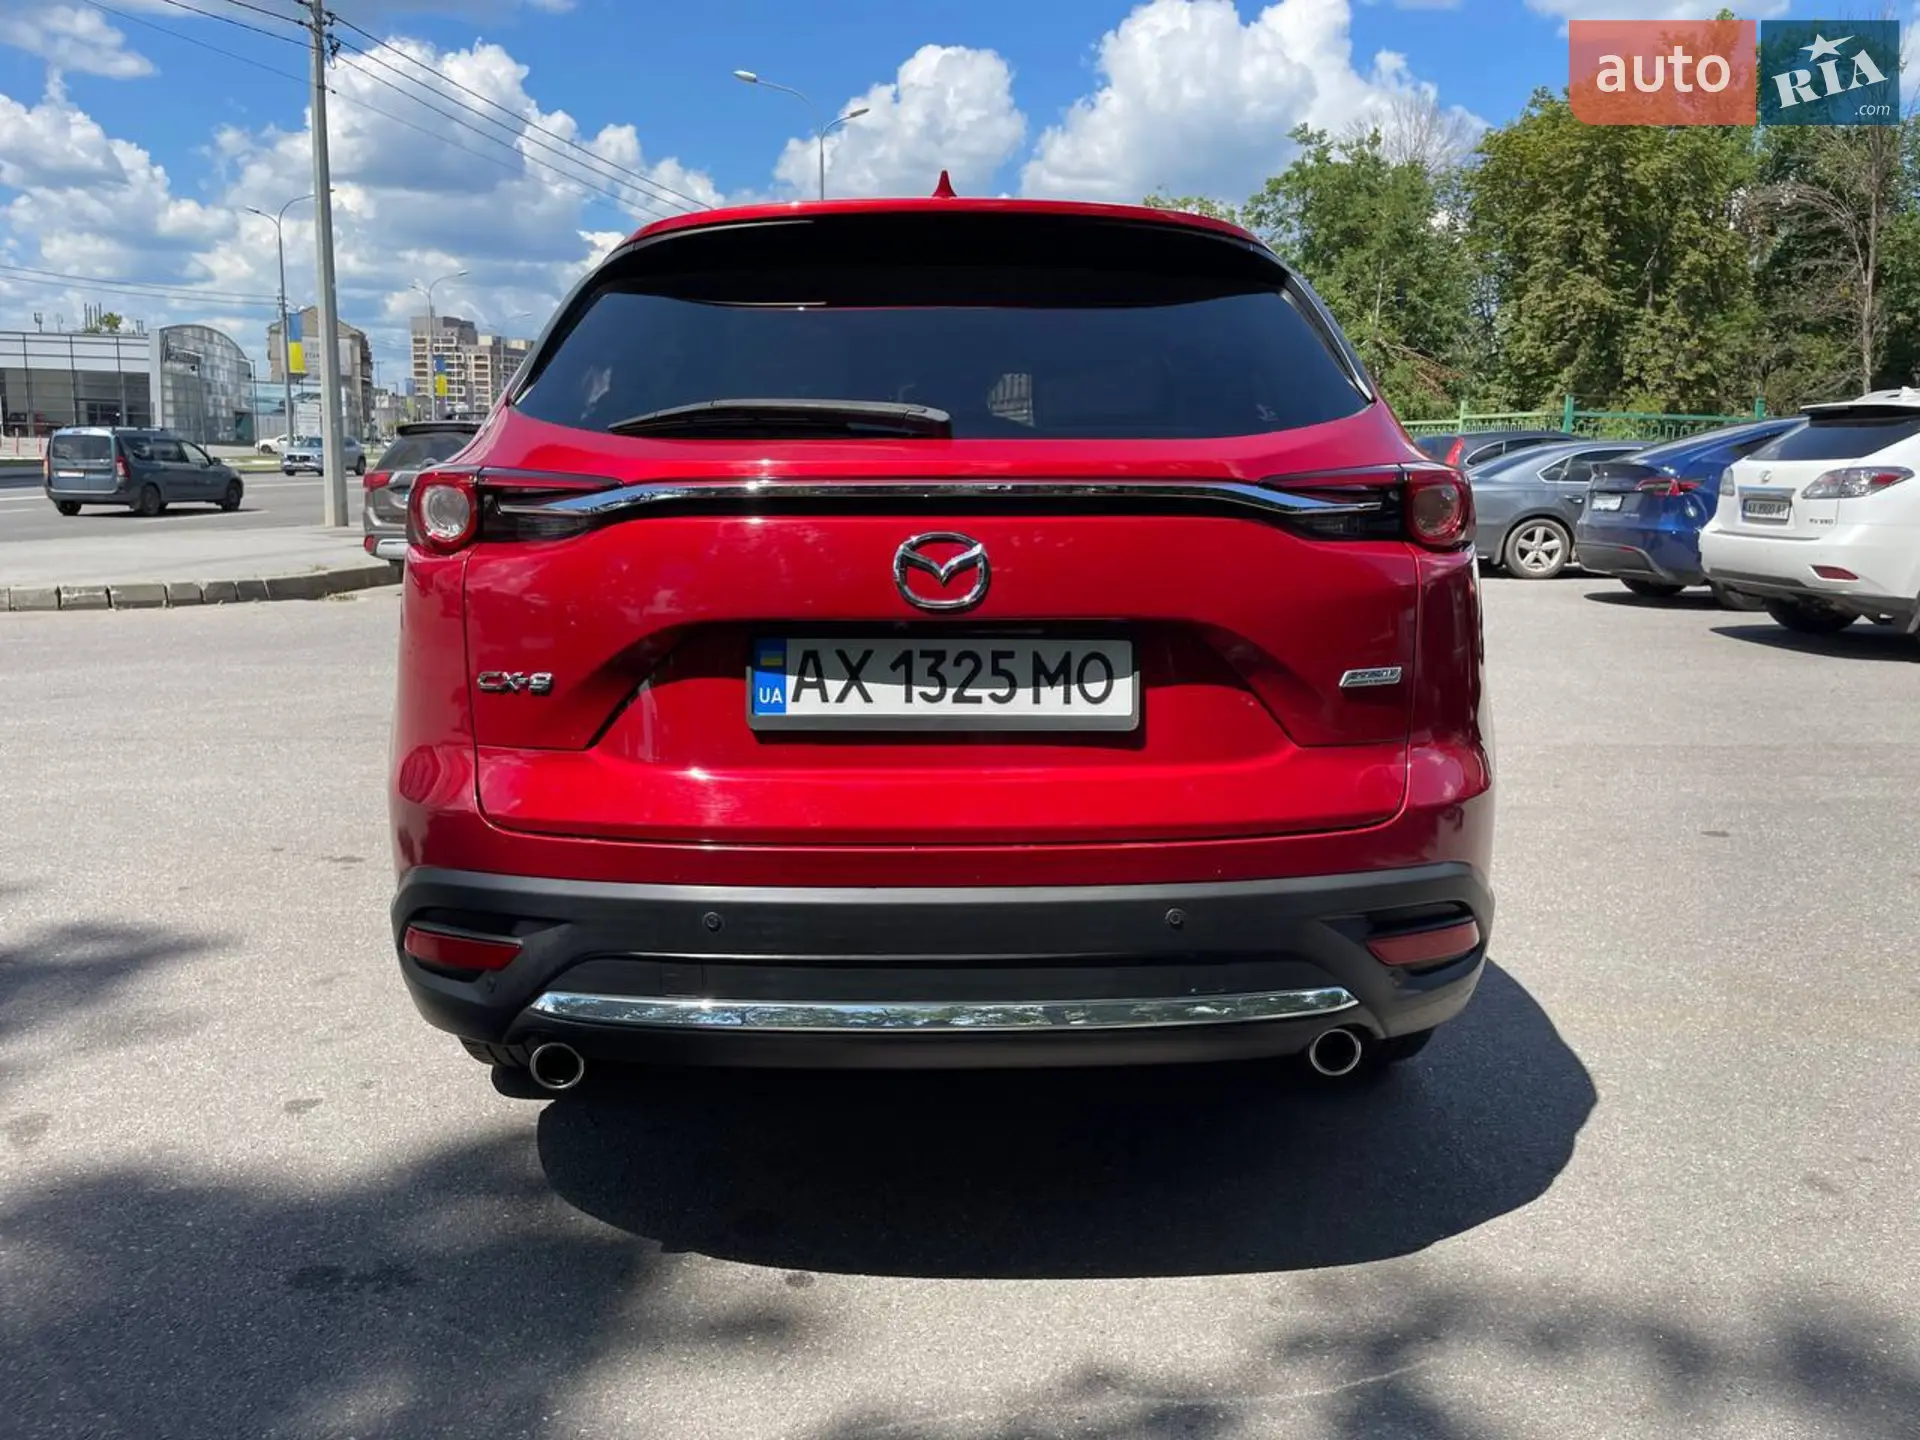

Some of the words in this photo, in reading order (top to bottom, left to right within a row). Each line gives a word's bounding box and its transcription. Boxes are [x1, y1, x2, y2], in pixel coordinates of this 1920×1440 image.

[758, 686, 784, 705] UA
[791, 649, 875, 704] AX
[889, 650, 1018, 705] 1325
[1032, 650, 1114, 705] MO
